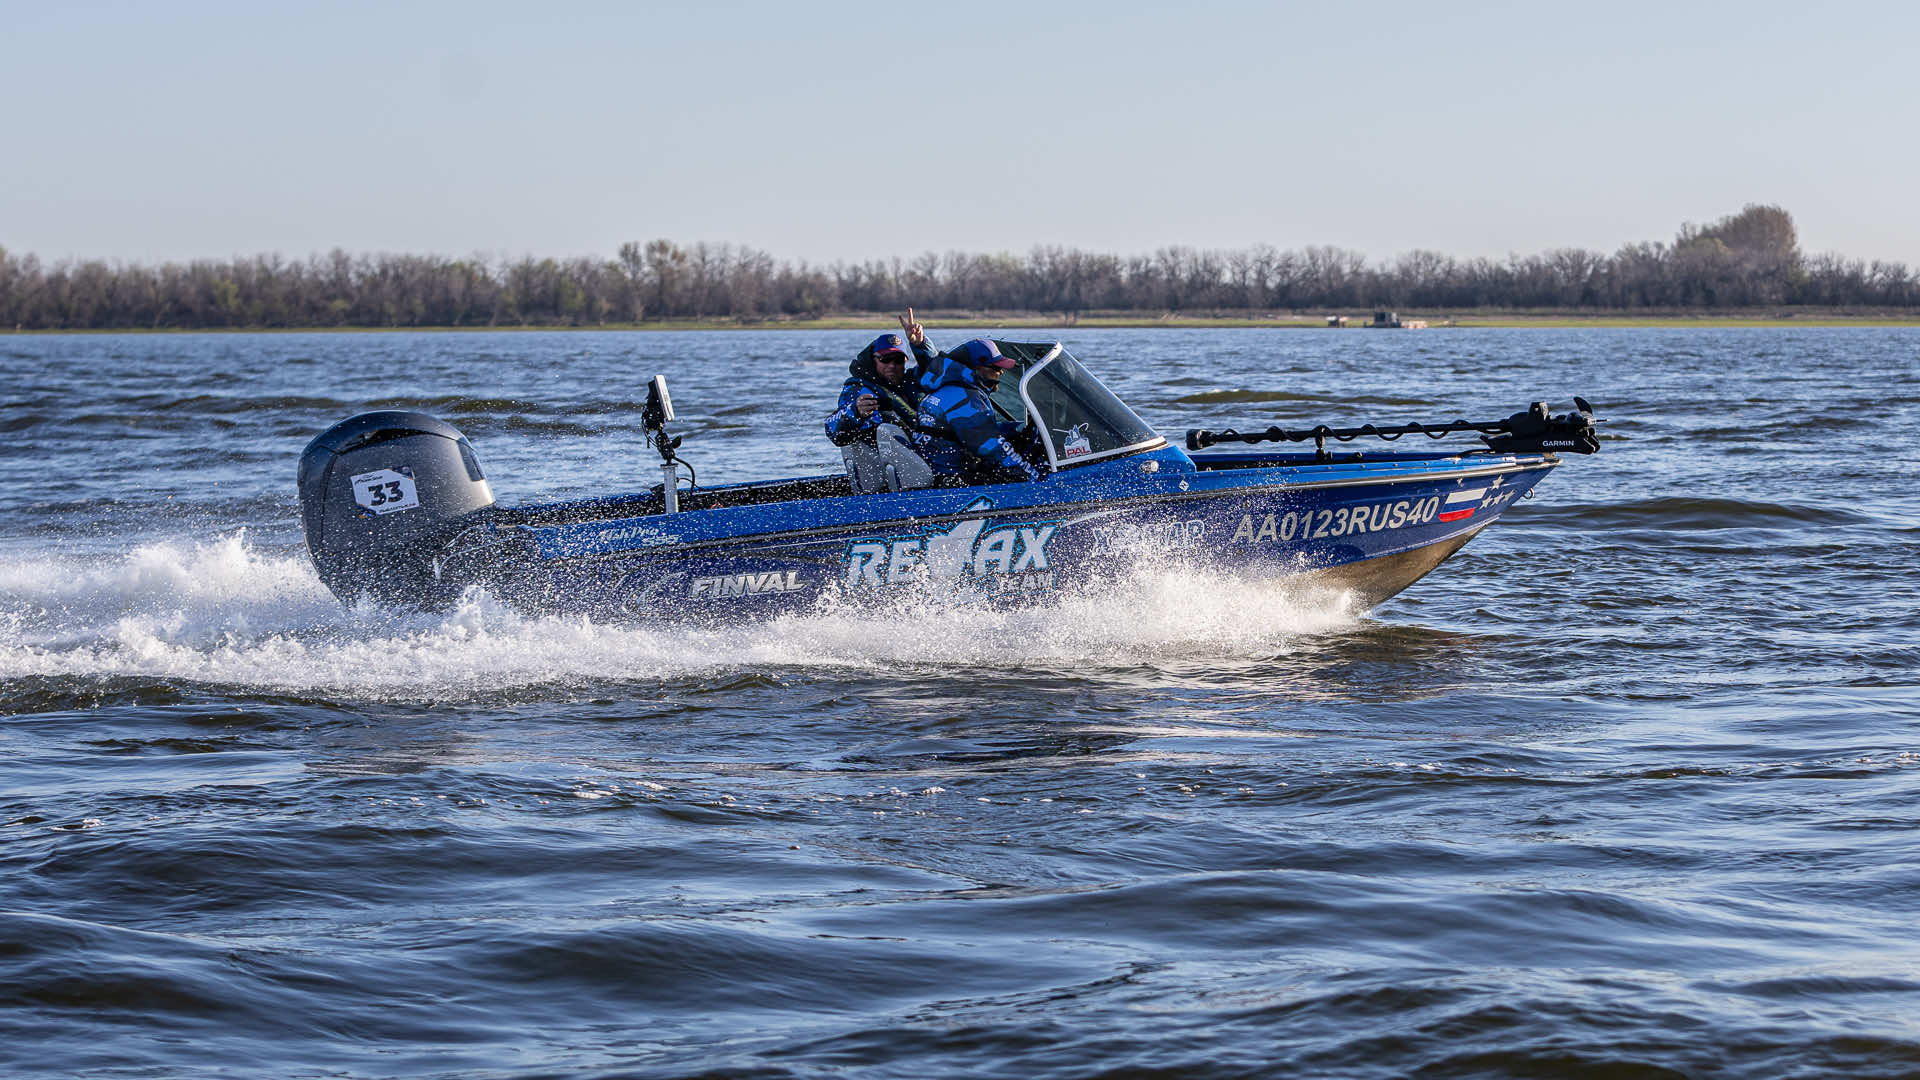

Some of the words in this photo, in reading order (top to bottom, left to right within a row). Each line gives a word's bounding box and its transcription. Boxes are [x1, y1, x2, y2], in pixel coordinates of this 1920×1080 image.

[367, 480, 404, 507] 33
[1231, 496, 1440, 544] AA0123RUS40
[690, 571, 808, 598] FINVAL
